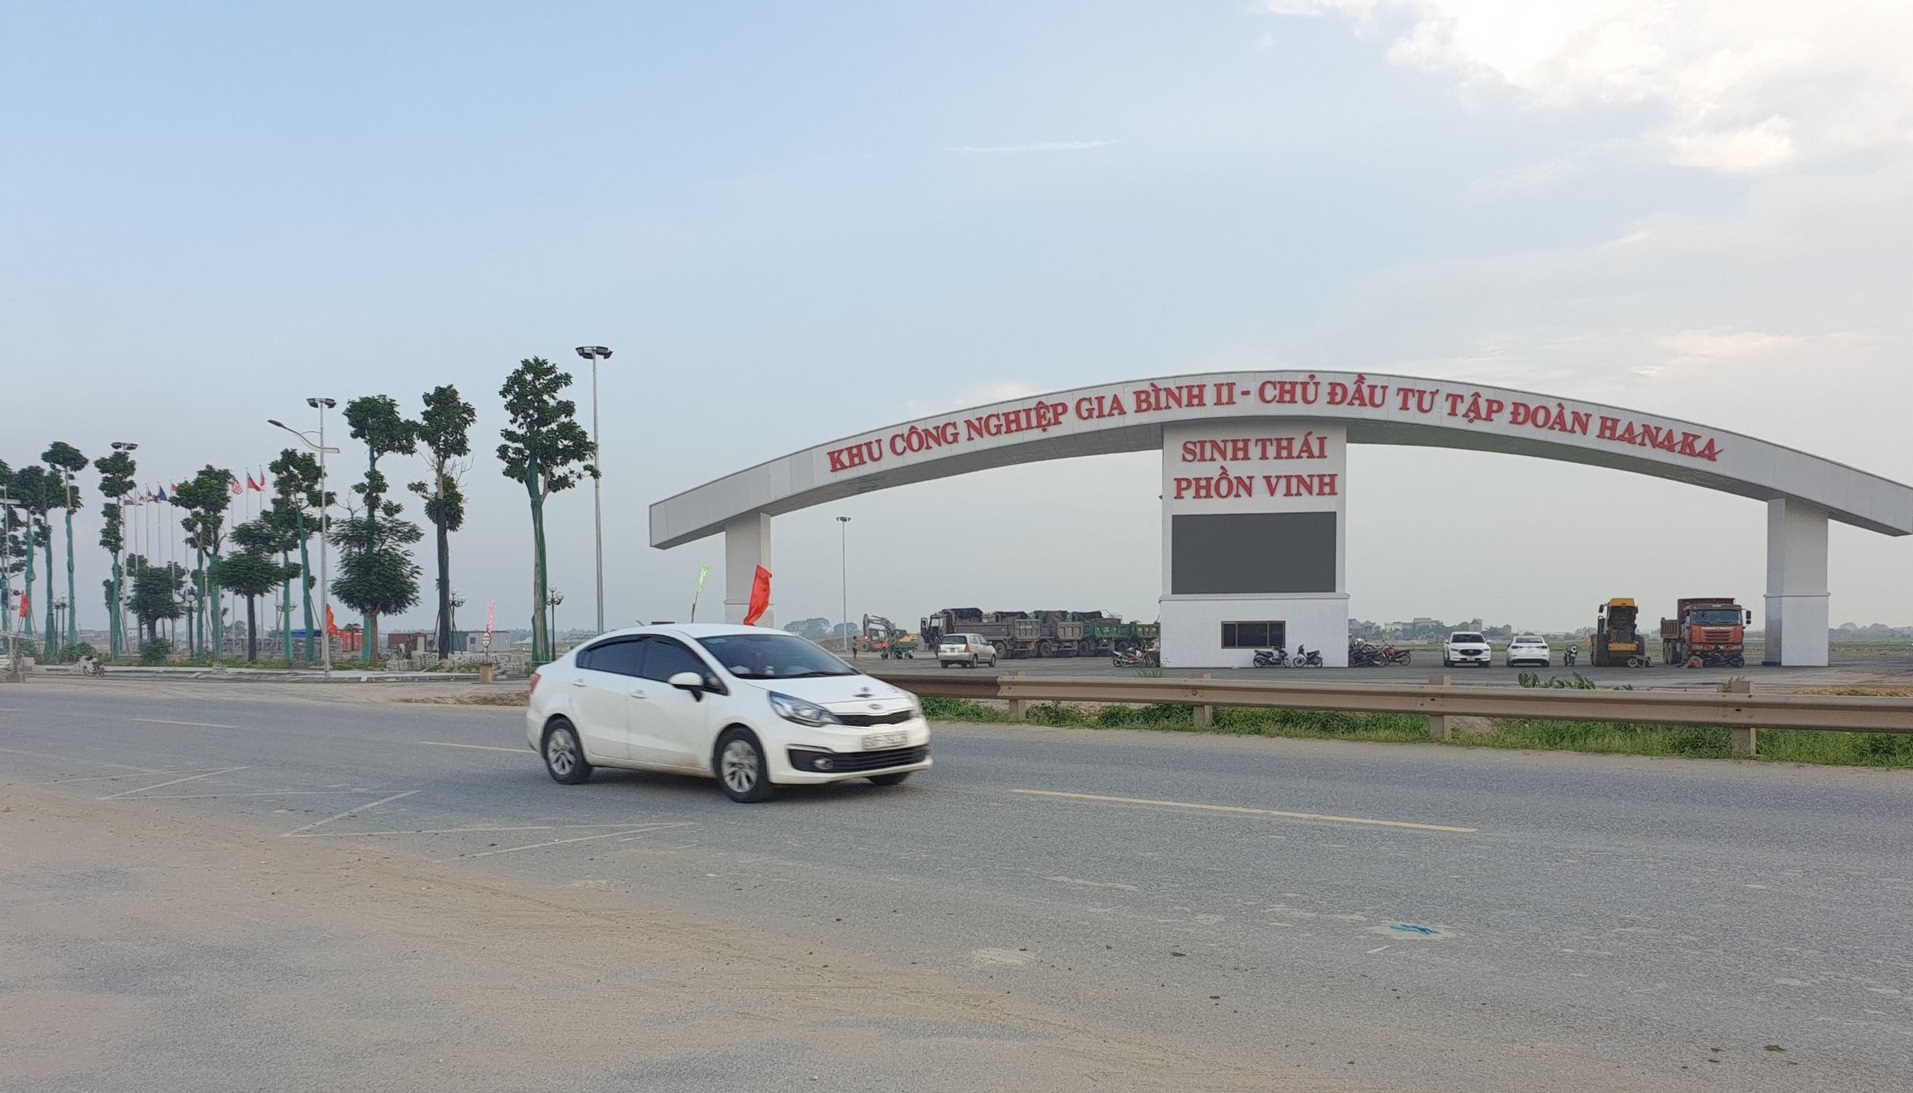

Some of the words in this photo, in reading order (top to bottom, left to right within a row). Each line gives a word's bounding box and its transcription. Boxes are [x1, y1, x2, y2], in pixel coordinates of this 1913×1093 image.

[827, 439, 883, 472] KHU
[889, 424, 960, 456] CÔNG
[964, 401, 1069, 441] NGHIỆP
[1075, 395, 1126, 422] GIA
[1133, 383, 1206, 413] BÌNH
[1214, 382, 1236, 406] II
[1240, 388, 1251, 396] -
[1258, 374, 1320, 404] CHỦ
[1327, 374, 1388, 407] ĐẦU
[1396, 387, 1439, 414] TƯ
[1446, 392, 1504, 423] TẬP
[1509, 402, 1593, 435] ĐOÀN
[1598, 416, 1724, 462] HANAKA
[1181, 438, 1251, 462] SINH
[1254, 431, 1328, 460] THÁI
[1174, 466, 1254, 500] PHỒN
[1262, 473, 1338, 498] VINH
